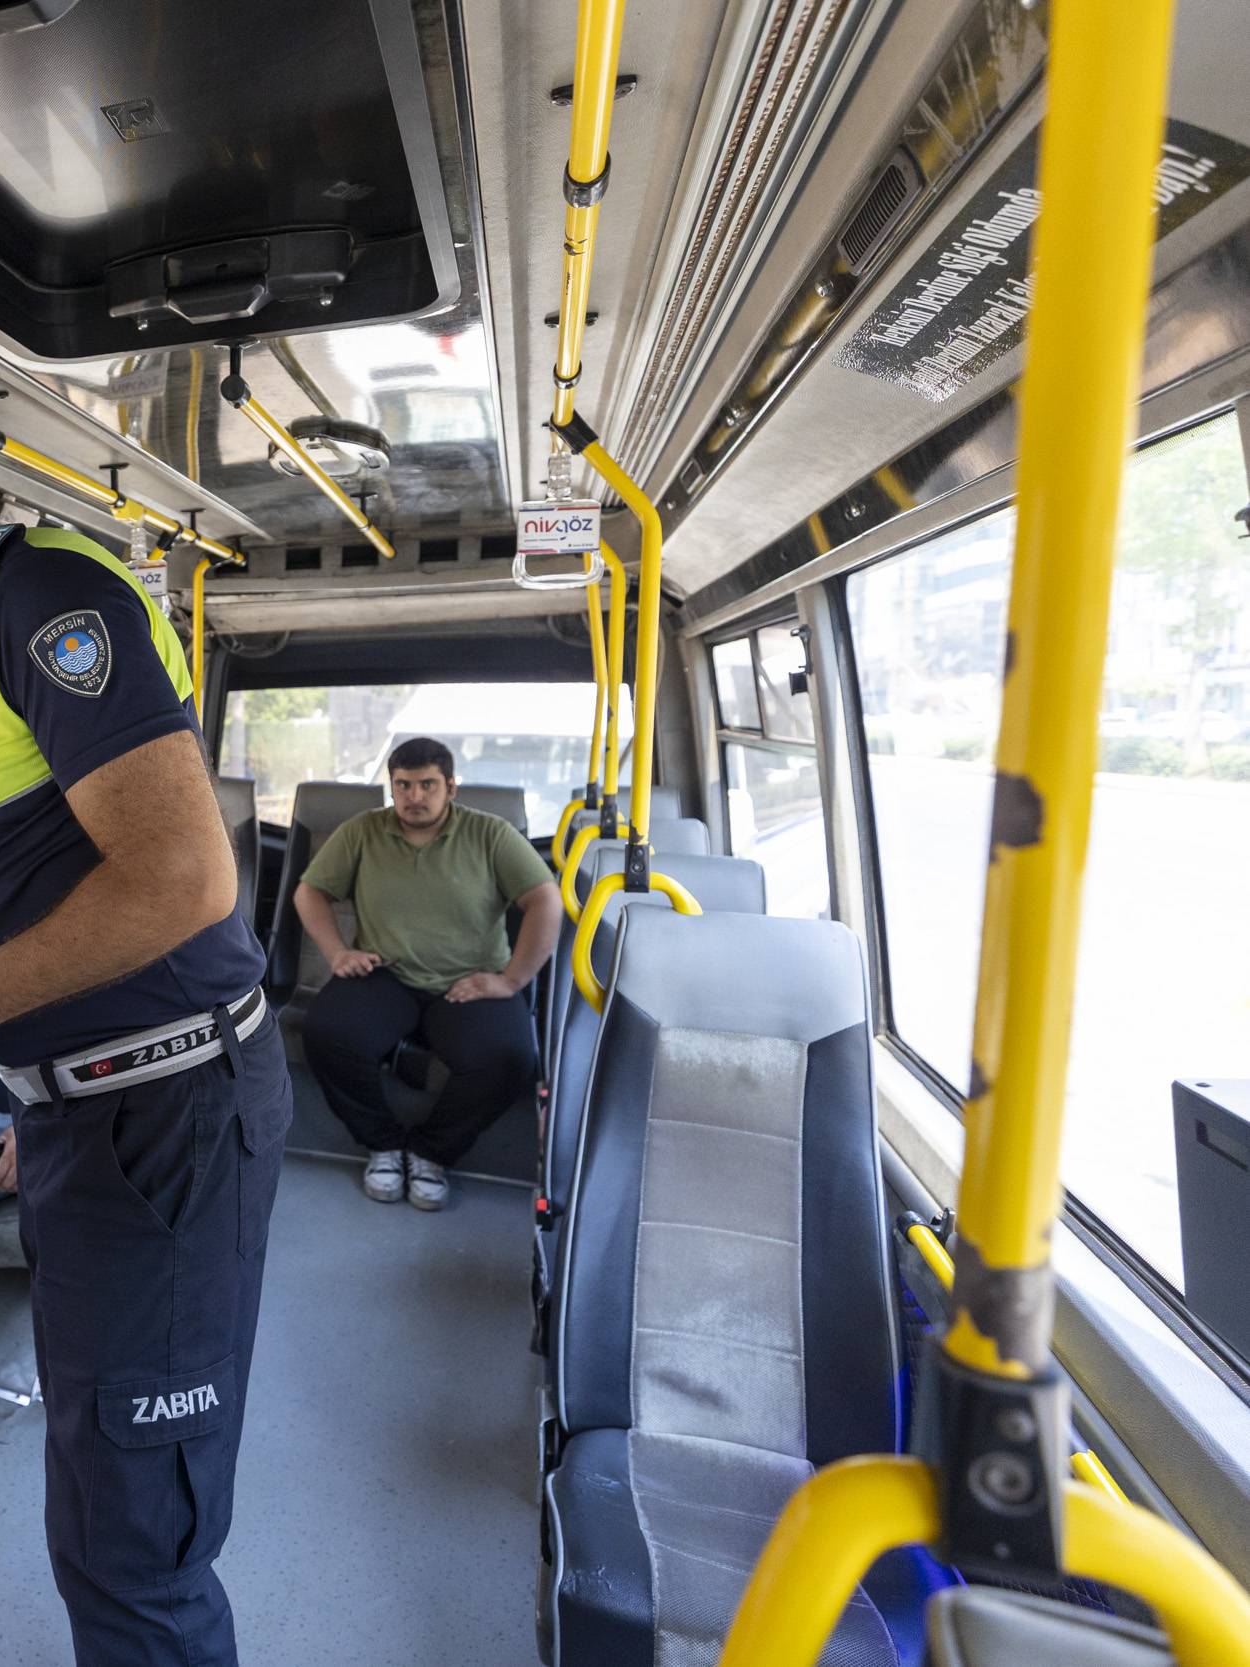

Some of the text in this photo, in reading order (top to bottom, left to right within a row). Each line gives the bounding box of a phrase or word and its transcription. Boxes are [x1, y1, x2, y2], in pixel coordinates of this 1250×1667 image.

[938, 241, 1008, 276] Silgi
[902, 270, 973, 313] Derdine
[954, 299, 1029, 343] Yazacak
[994, 272, 1038, 310] Kale
[869, 309, 937, 348] Herkesin
[43, 616, 86, 645] MERSİN
[82, 675, 102, 689] 1873
[131, 1383, 220, 1424] ZABITA
